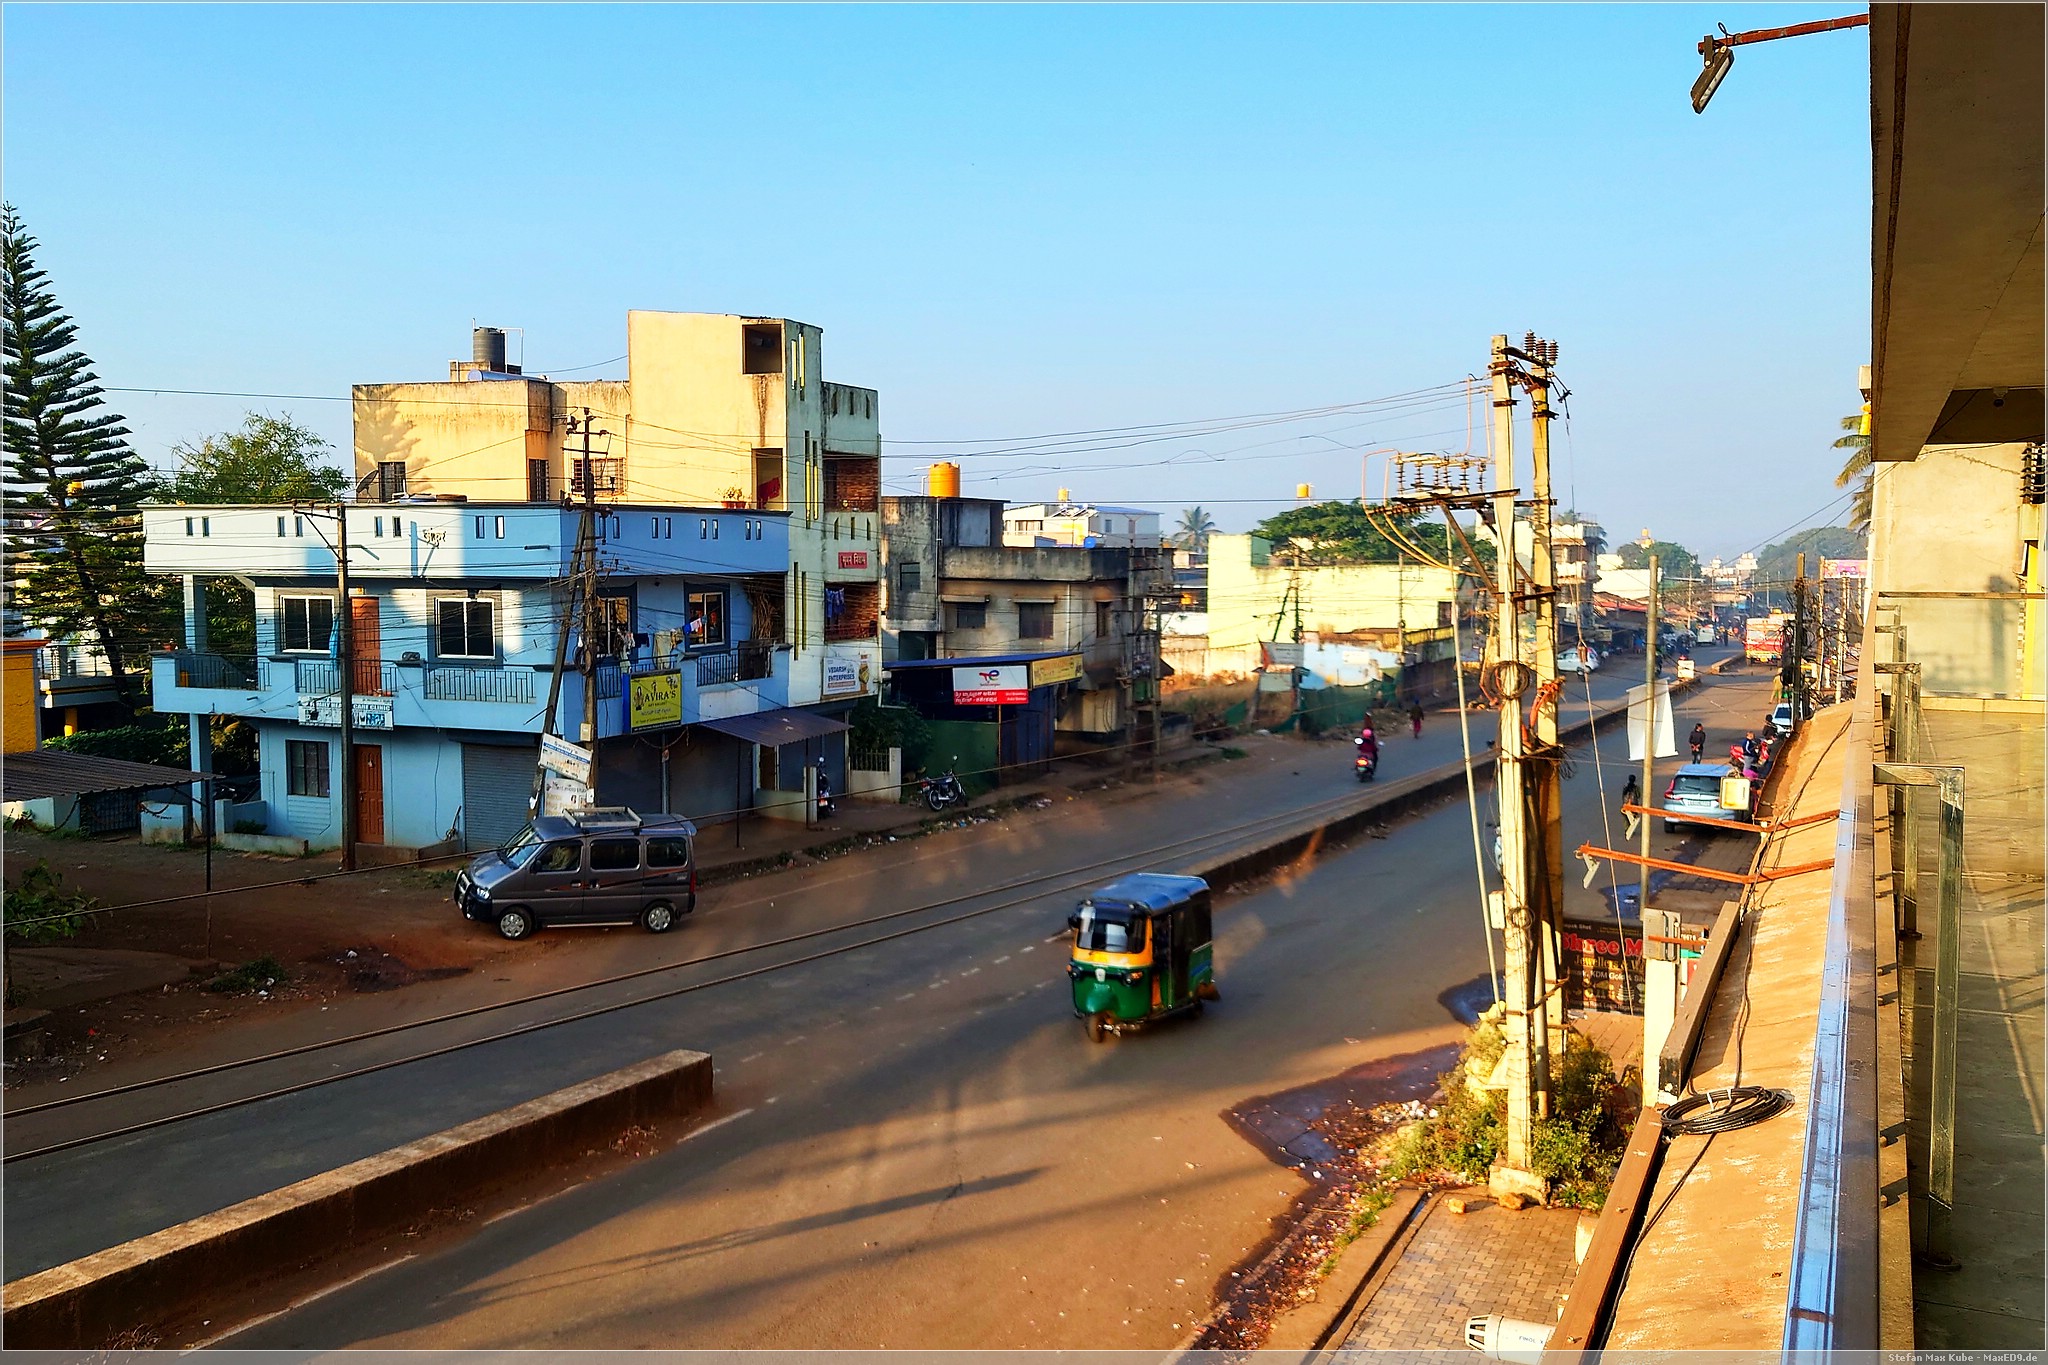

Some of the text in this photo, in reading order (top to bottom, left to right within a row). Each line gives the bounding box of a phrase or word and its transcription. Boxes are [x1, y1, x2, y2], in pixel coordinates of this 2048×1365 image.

[828, 673, 855, 681] ENTERPRISES
[1563, 932, 1620, 955] Shree
[1574, 955, 1619, 968] Jewellers
